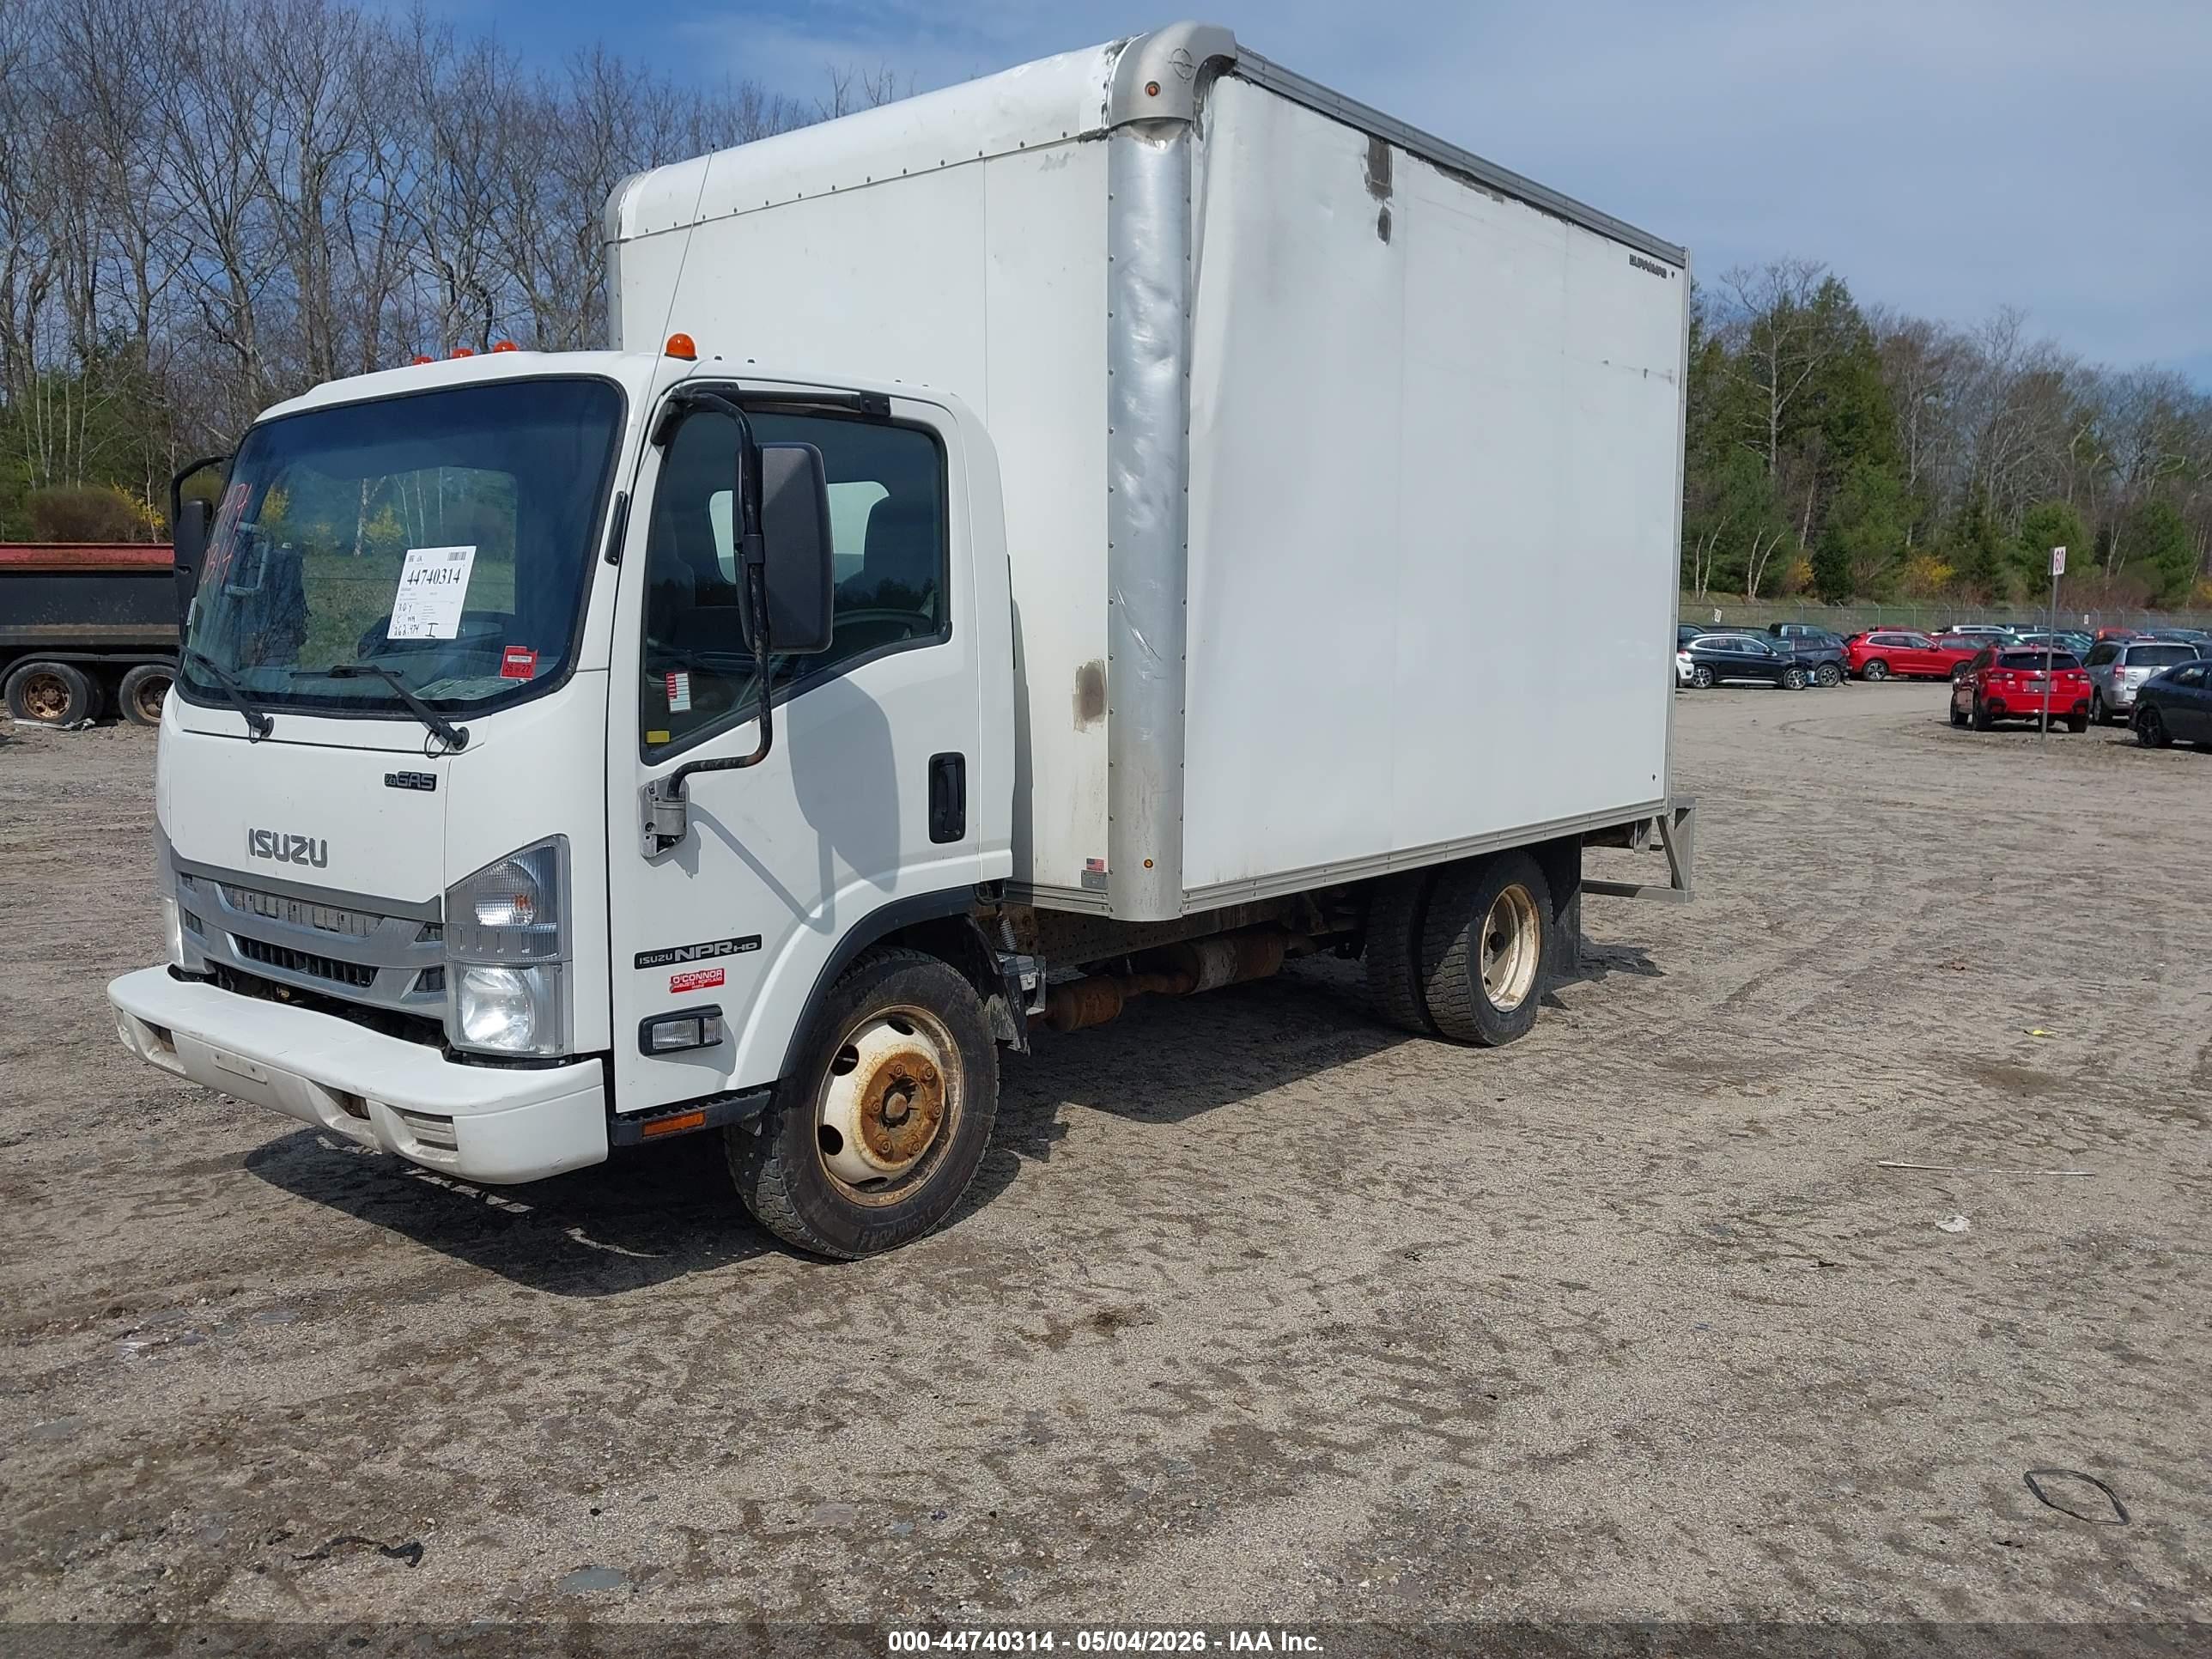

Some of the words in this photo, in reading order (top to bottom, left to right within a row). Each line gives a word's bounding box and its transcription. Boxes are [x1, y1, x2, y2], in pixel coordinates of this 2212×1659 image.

[406, 567, 461, 586] 44740314
[521, 664, 532, 673] 27
[397, 772, 434, 789] GAS
[248, 828, 328, 868] ISUZU
[639, 952, 673, 965] ISUZU
[674, 941, 734, 962] NPR
[733, 942, 758, 952] HD
[672, 969, 723, 984] O'CONNOR
[697, 976, 723, 985] PORTLAND
